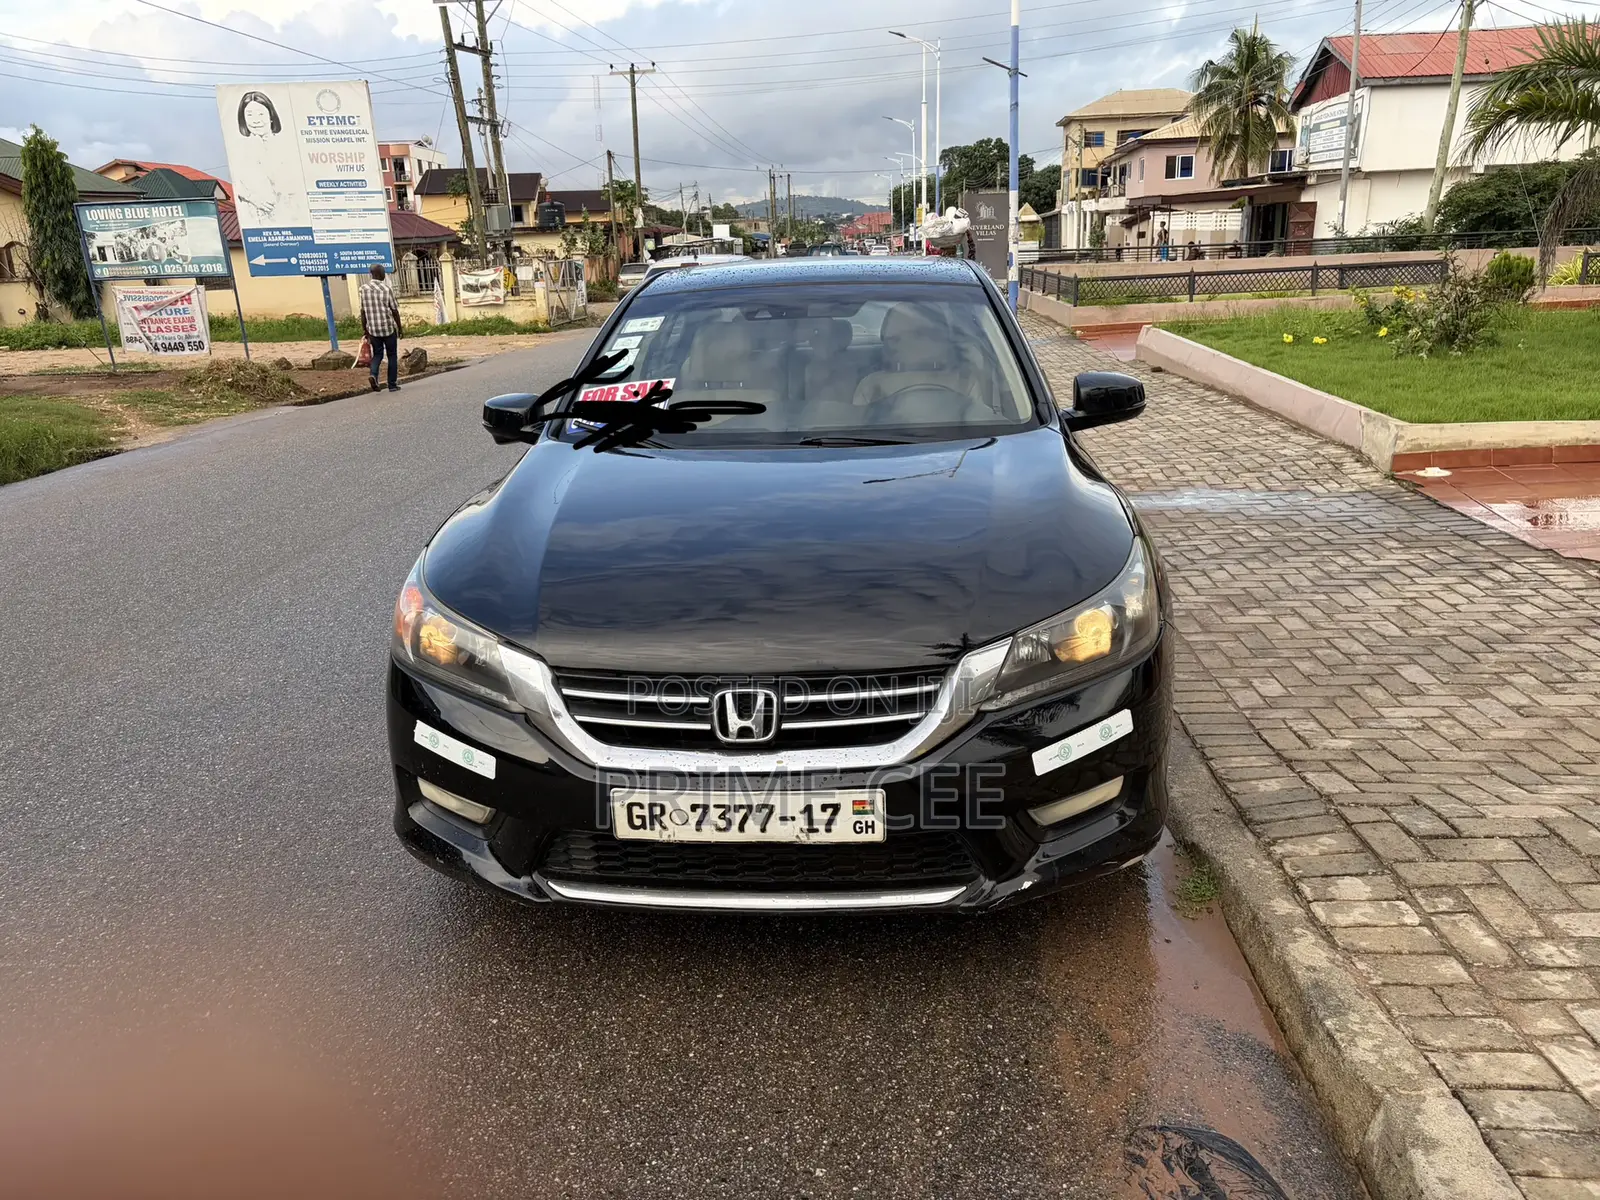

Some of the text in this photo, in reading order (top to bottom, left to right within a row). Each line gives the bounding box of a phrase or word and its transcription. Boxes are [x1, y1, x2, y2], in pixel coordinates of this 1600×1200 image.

[307, 115, 356, 126] ETEMC
[308, 152, 366, 164] WORSHIP
[336, 164, 366, 172] WITH US
[86, 205, 185, 221] LOVING BLUE HOTEL
[164, 264, 182, 274] 025
[182, 263, 199, 273] 748
[199, 263, 223, 273] 2018
[173, 315, 196, 324] EXAMS
[140, 324, 198, 334] CLASSES
[161, 341, 186, 352] 9449
[187, 340, 205, 351] 550
[582, 386, 620, 402] FOR
[626, 801, 669, 831] GR
[852, 820, 876, 834] GH
